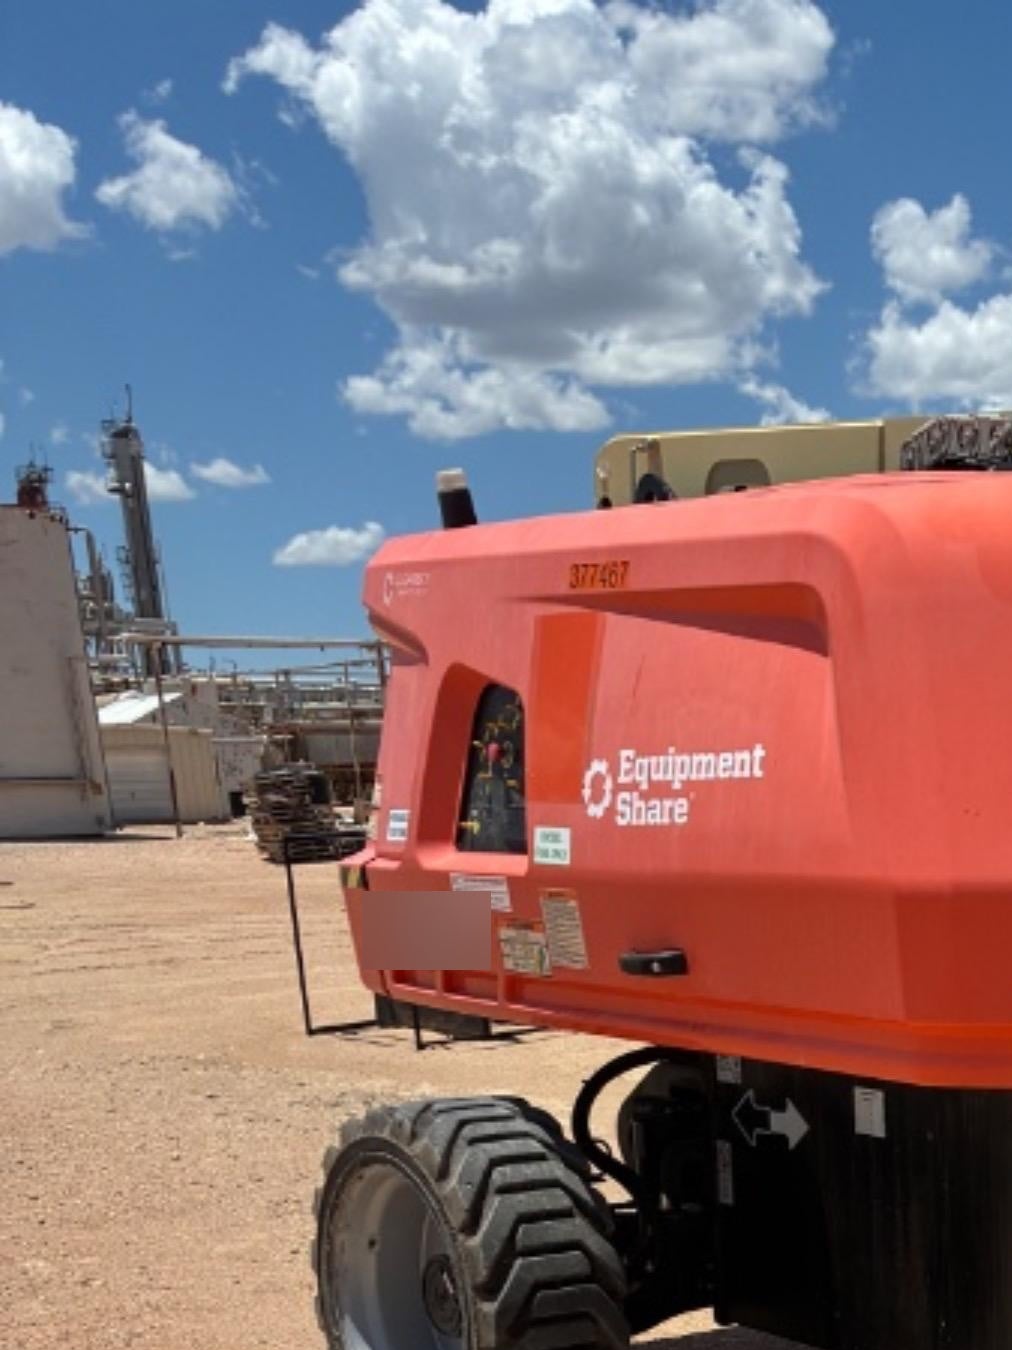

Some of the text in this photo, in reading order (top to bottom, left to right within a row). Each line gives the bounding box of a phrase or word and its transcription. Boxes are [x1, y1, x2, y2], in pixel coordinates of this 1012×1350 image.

[569, 560, 630, 589] 377467
[617, 743, 765, 790] Equipment
[616, 791, 688, 826] Share
